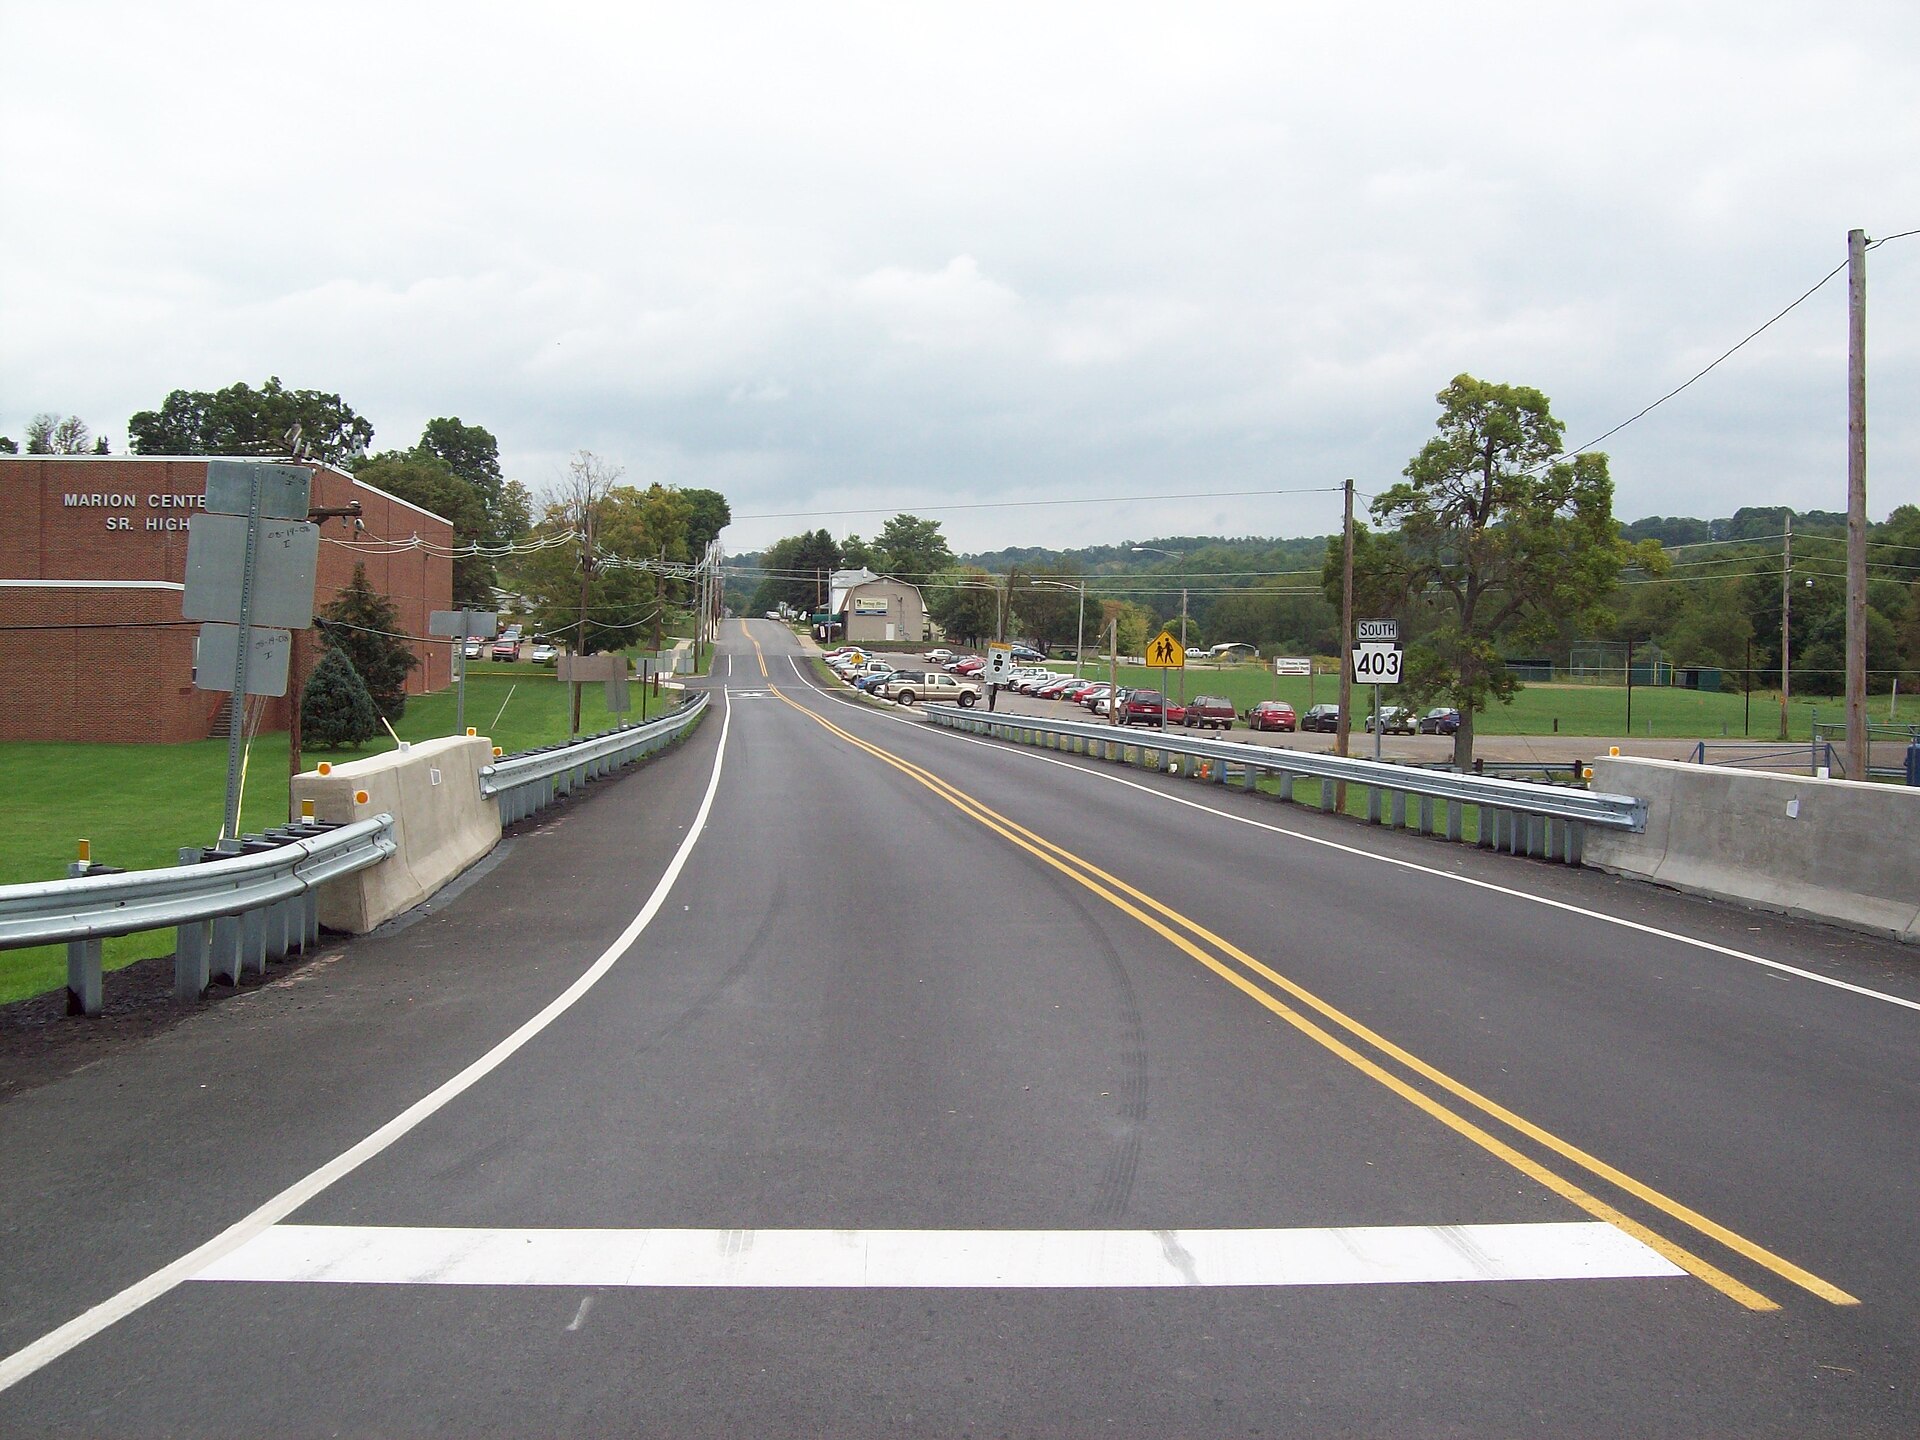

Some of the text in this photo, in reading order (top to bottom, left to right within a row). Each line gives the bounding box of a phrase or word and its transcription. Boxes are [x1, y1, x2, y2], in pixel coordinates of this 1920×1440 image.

[64, 493, 206, 508] MARION CENTE
[106, 517, 191, 531] SR. HIGH
[1360, 622, 1395, 636] SOUTH
[1357, 652, 1399, 675] 403
